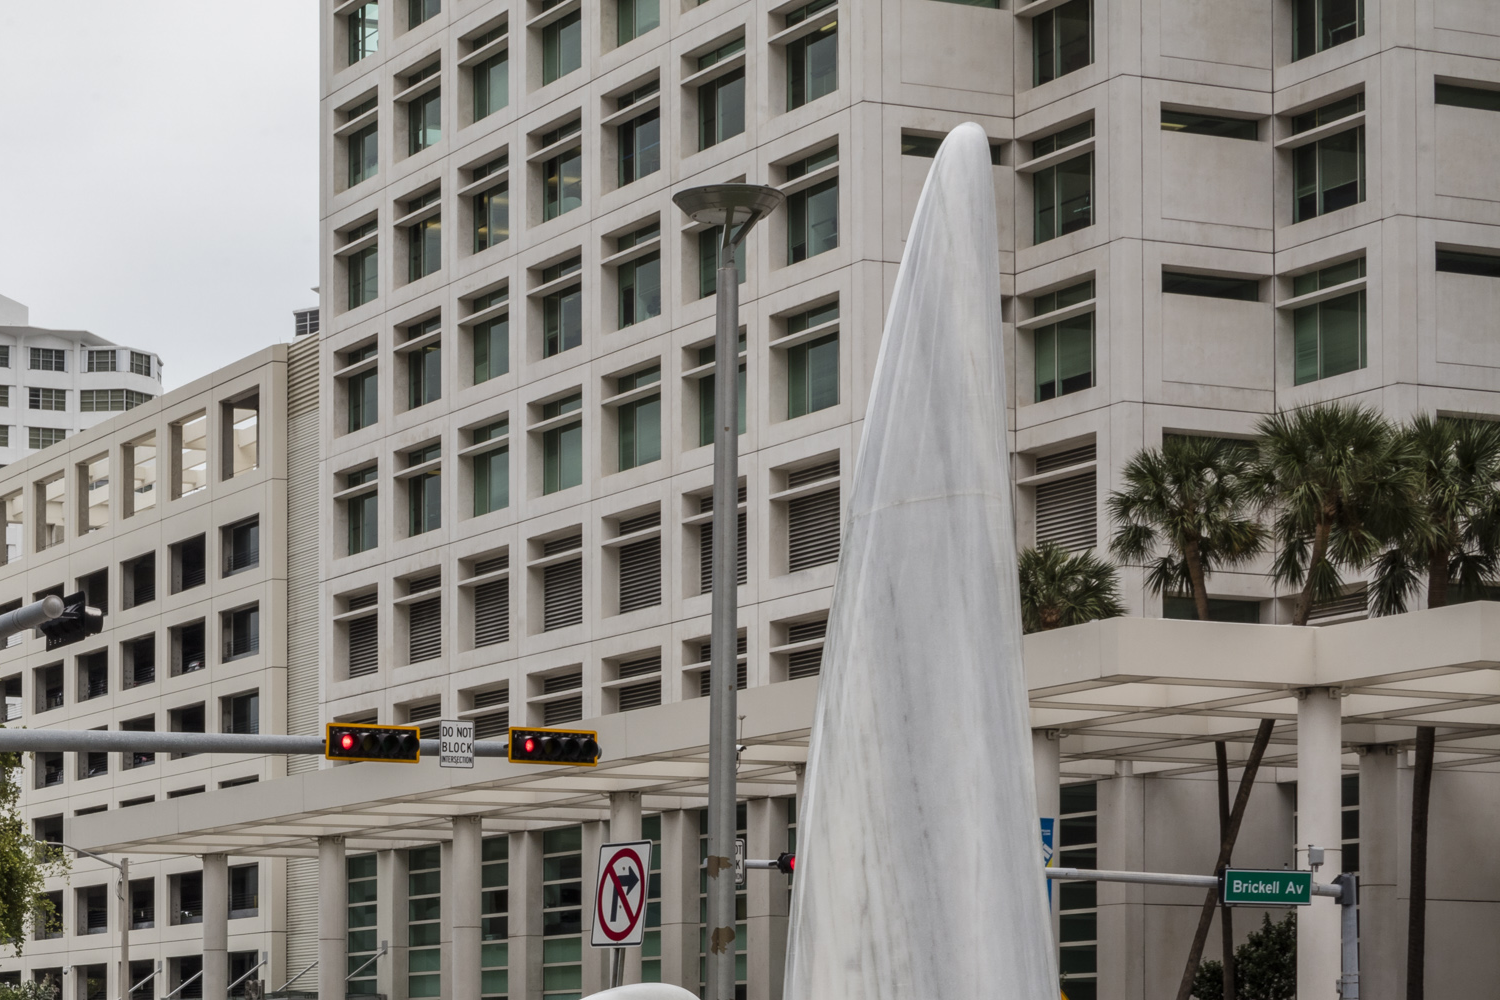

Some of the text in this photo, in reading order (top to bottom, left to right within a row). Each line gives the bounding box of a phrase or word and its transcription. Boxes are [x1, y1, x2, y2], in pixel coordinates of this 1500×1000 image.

[442, 726, 473, 738] DO NOT
[442, 741, 473, 753] BLOCK
[1233, 880, 1304, 895] Brickell Av
